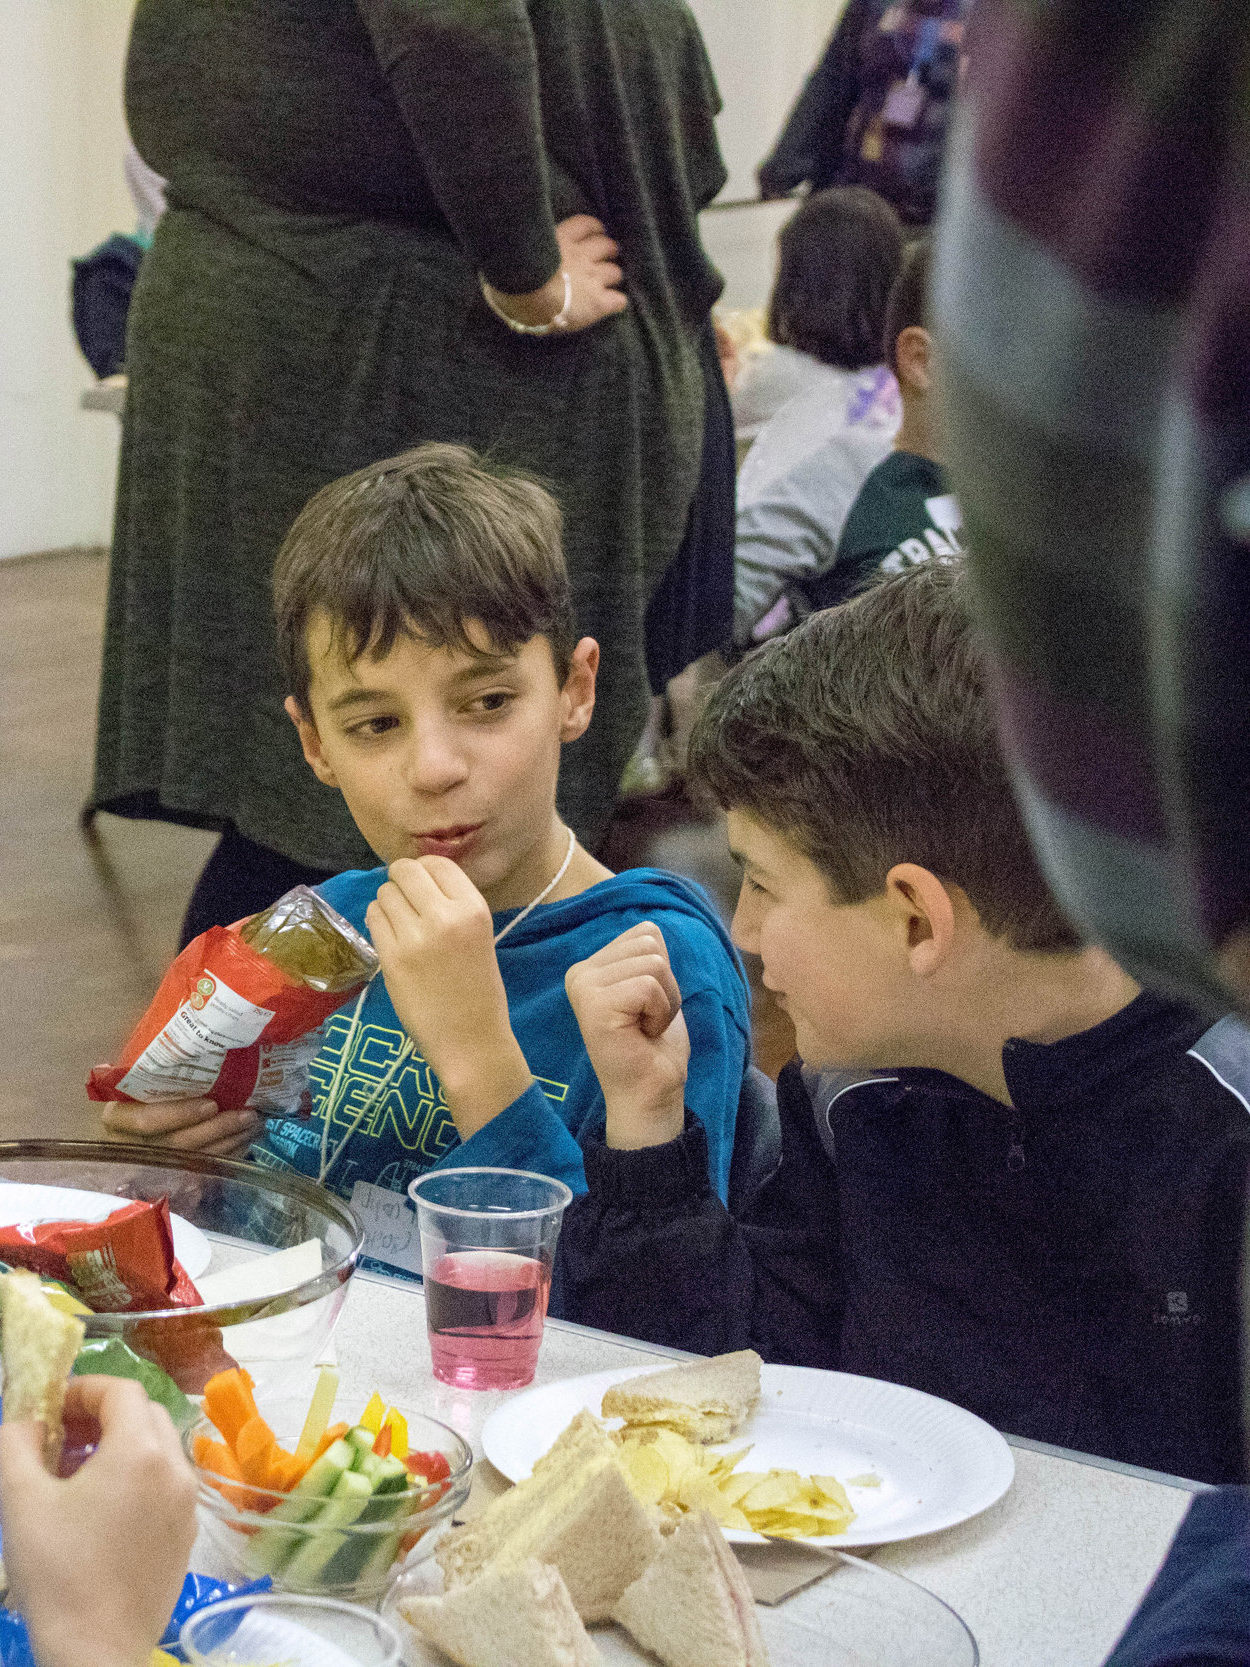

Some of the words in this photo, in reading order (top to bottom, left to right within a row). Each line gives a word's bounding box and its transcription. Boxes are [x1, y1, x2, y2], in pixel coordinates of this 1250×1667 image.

[180, 1011, 197, 1031] Great
[195, 1029, 204, 1039] to
[204, 1035, 226, 1049] know
